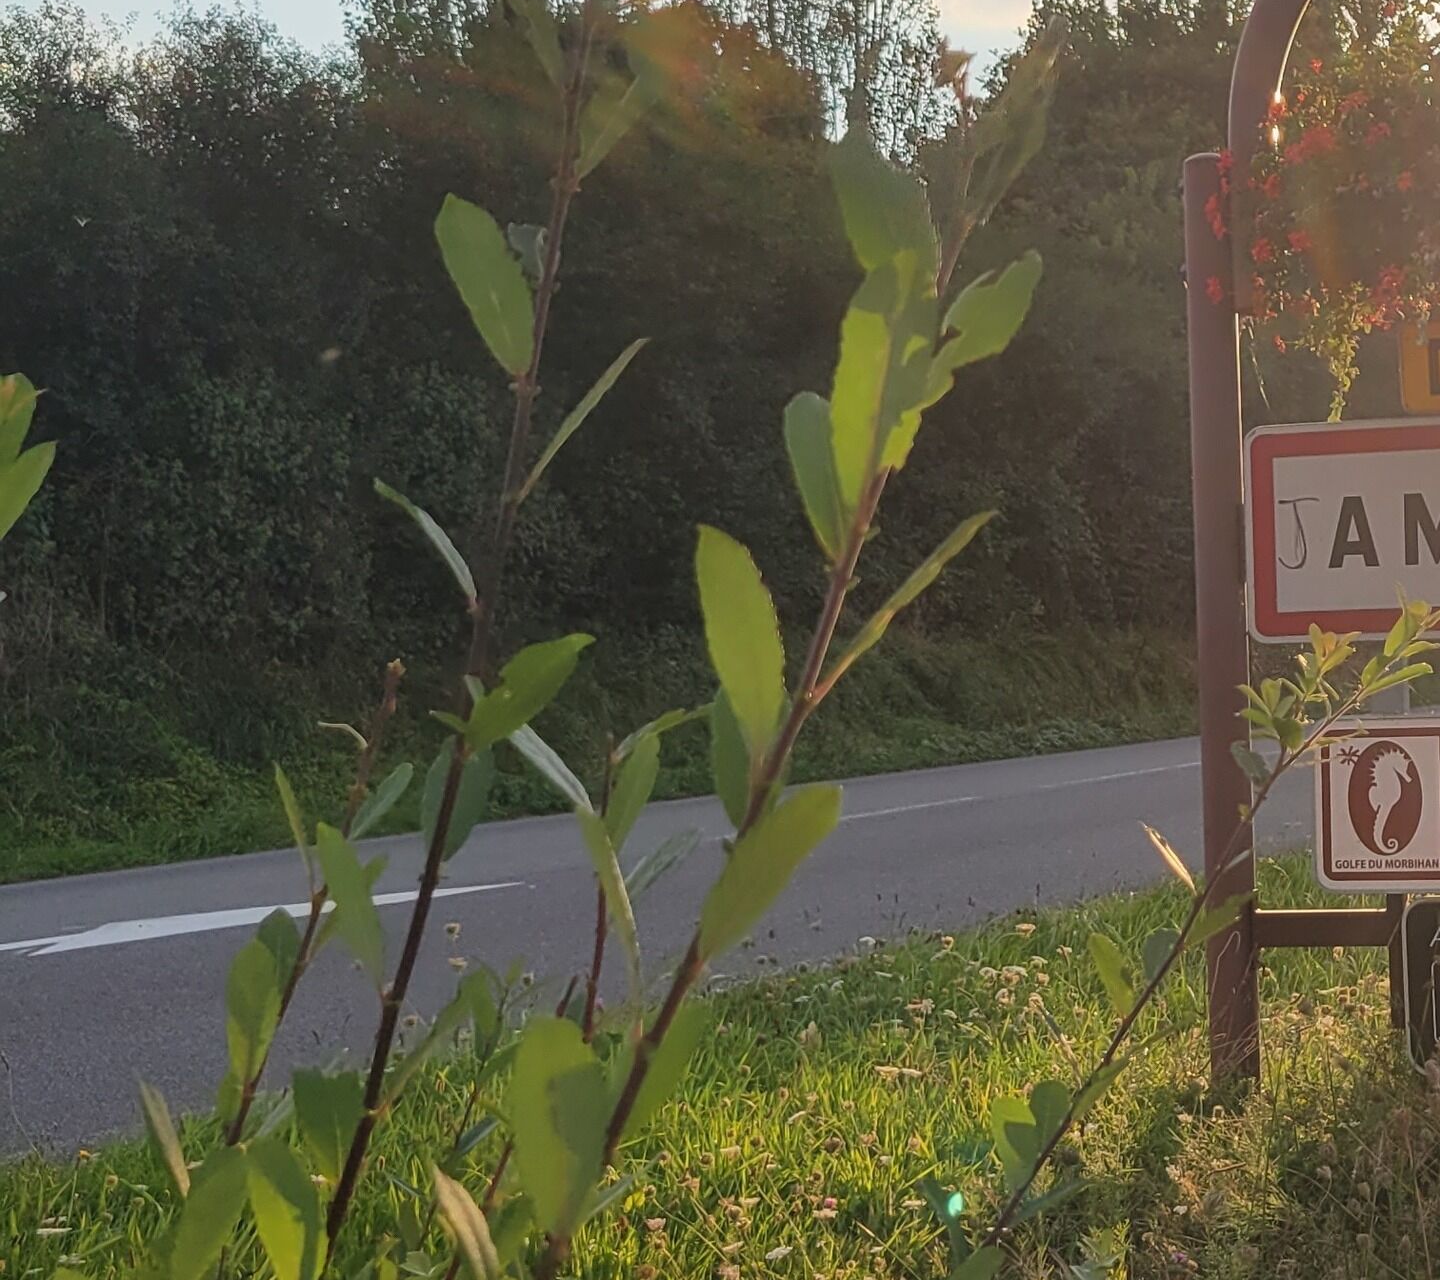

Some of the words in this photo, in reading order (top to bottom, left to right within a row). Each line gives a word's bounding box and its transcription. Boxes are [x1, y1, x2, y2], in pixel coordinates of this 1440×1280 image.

[1335, 859, 1366, 869] GOLFE
[1368, 859, 1382, 869] DU
[1385, 858, 1439, 869] MORBIHAN
